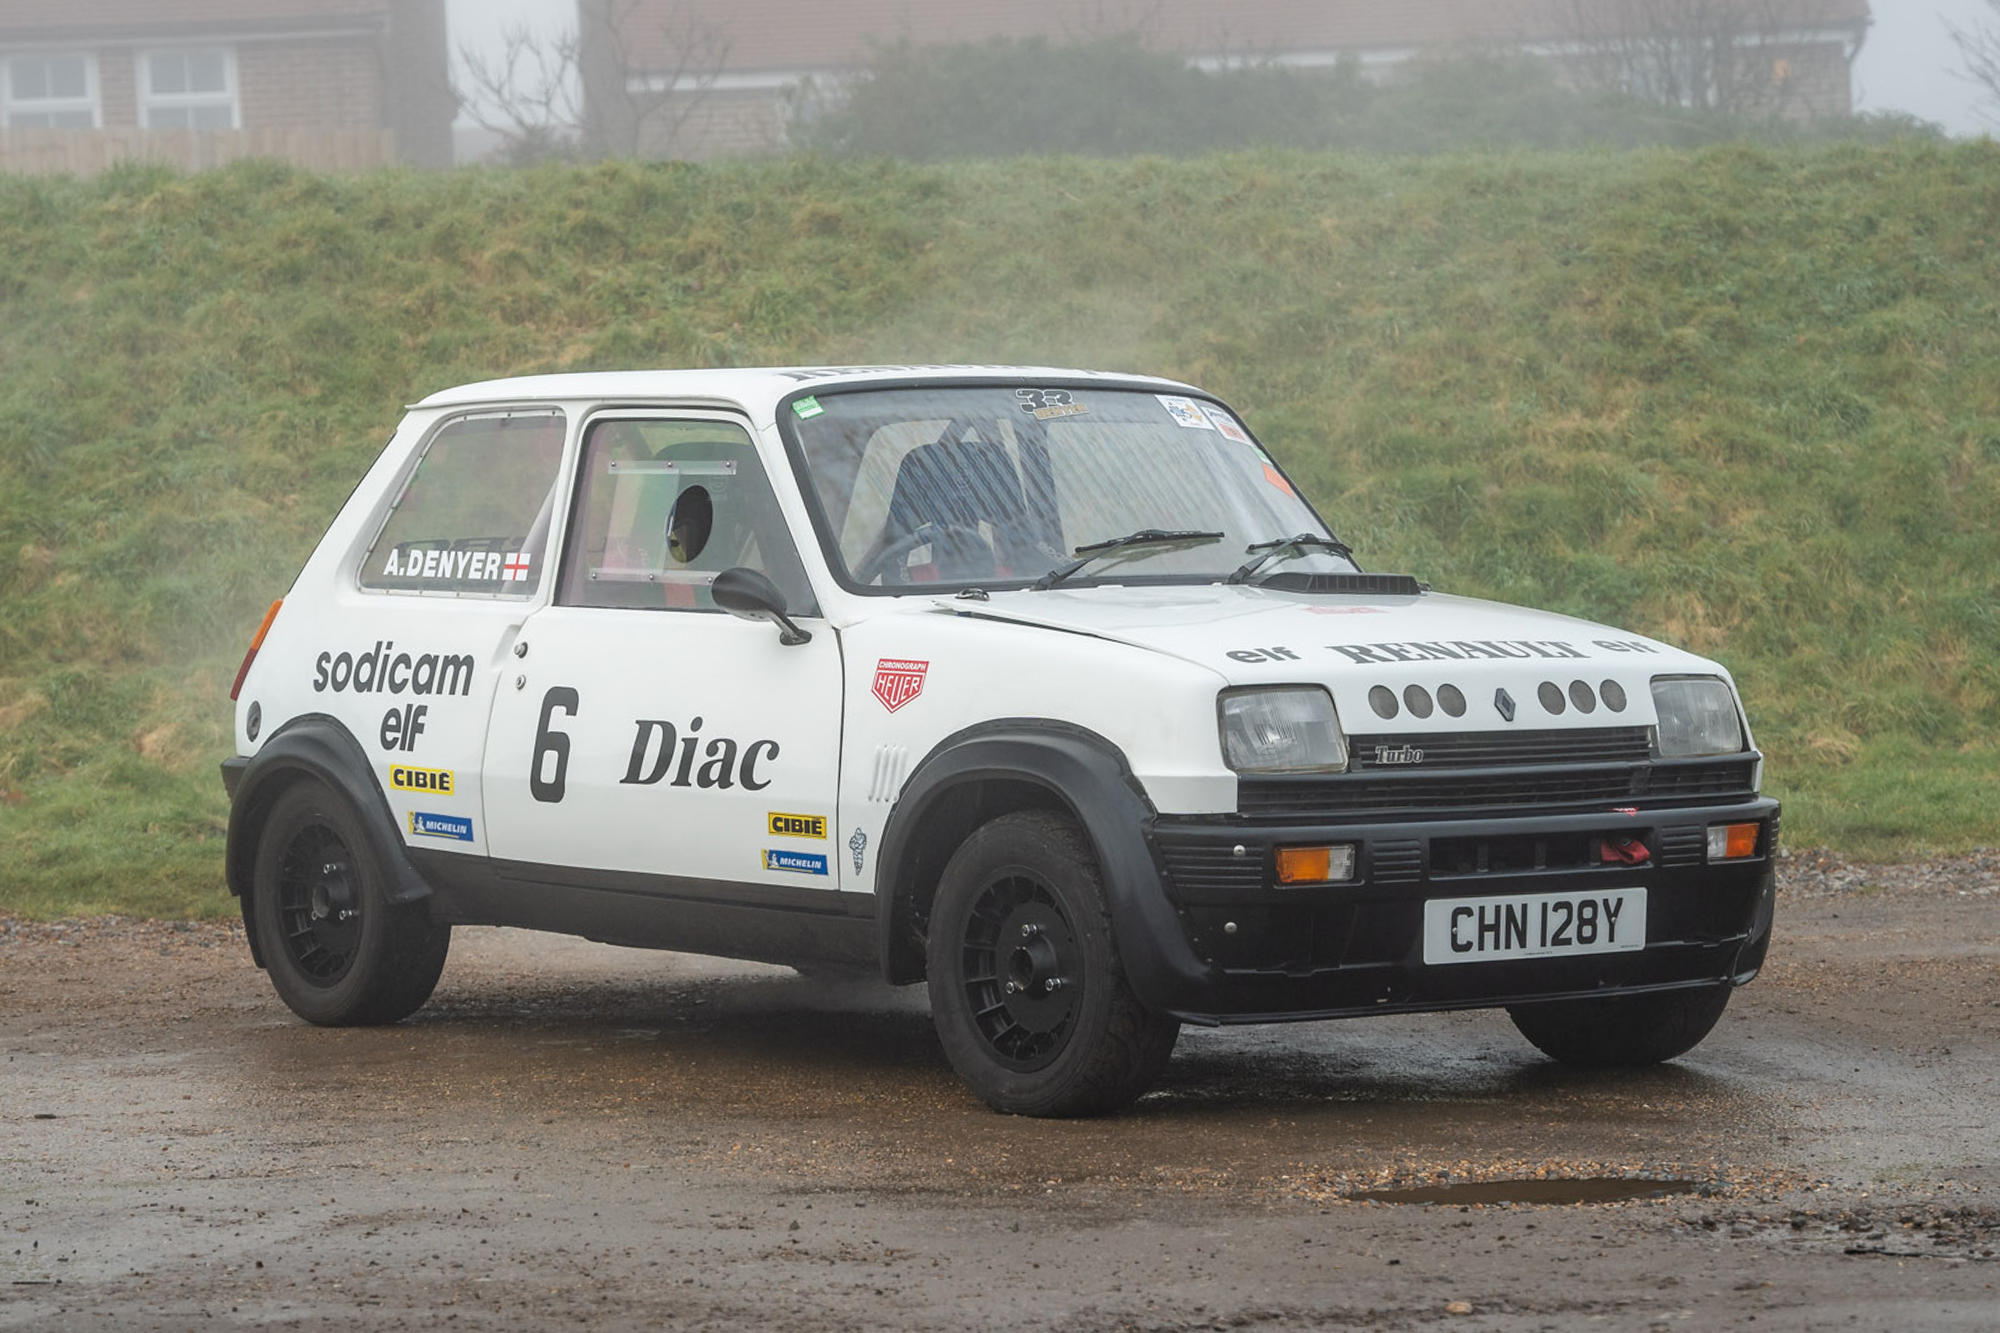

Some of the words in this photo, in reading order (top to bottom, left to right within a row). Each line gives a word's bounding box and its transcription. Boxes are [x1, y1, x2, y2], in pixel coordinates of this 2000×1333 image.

[383, 548, 501, 581] A.DENYER
[879, 661, 927, 671] CHRONOGRAPH
[1226, 646, 1302, 663] elf
[1324, 640, 1591, 664] RENAULT
[1592, 640, 1660, 653] elf
[313, 641, 475, 696] sodicam
[876, 675, 921, 706] HEUER
[380, 703, 428, 752] elf
[530, 686, 579, 803] 6
[619, 716, 780, 791] Diac
[1375, 745, 1424, 764] Turbo
[426, 820, 467, 834] MICHELIN
[780, 857, 821, 869] MICHELIN
[1451, 902, 1528, 953] CHN
[1540, 897, 1623, 947] 128Y
